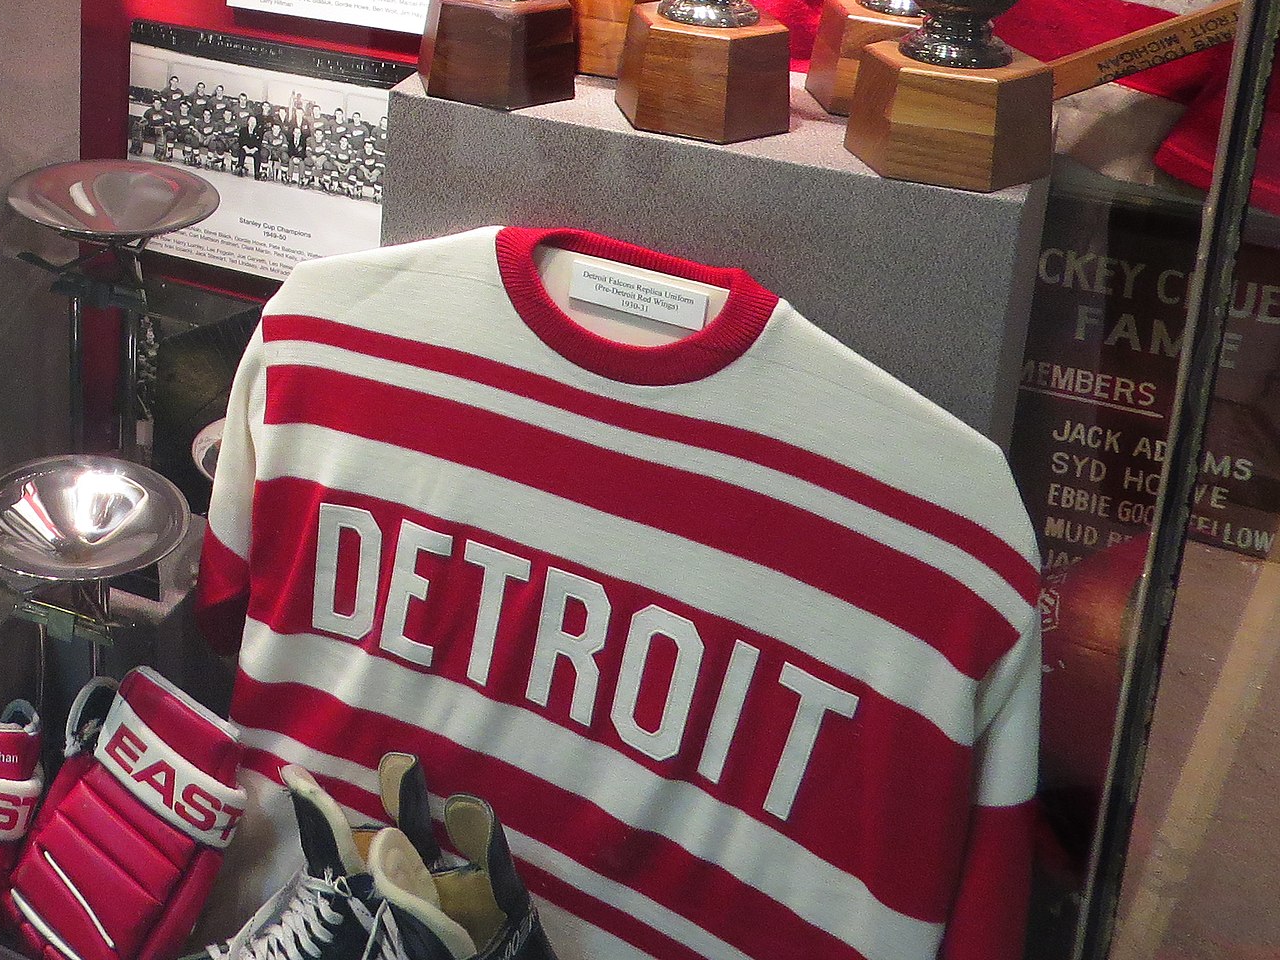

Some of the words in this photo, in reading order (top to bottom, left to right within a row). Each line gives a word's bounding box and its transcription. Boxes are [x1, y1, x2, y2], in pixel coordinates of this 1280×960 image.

[1097, 34, 1180, 73] MICHIGAN
[239, 217, 261, 229] Stanley
[263, 222, 276, 231] Cup
[277, 225, 312, 238] Champions
[263, 231, 287, 240] 1949-50
[583, 270, 606, 281] Detroit
[609, 277, 635, 289] Falcons
[637, 285, 662, 297] Replica
[665, 291, 694, 304] Uniform
[594, 283, 636, 299] (Pre-Detroit
[637, 294, 651, 303] Red
[654, 298, 679, 311] Wings)
[1021, 359, 1157, 407] MEMBERS
[1050, 452, 1108, 483] SYD
[1052, 420, 1122, 454] JACK
[1132, 438, 1255, 482] ADMS
[1047, 483, 1112, 518] EBBIE
[1044, 517, 1099, 546] MUD
[311, 502, 860, 822] DETROIT
